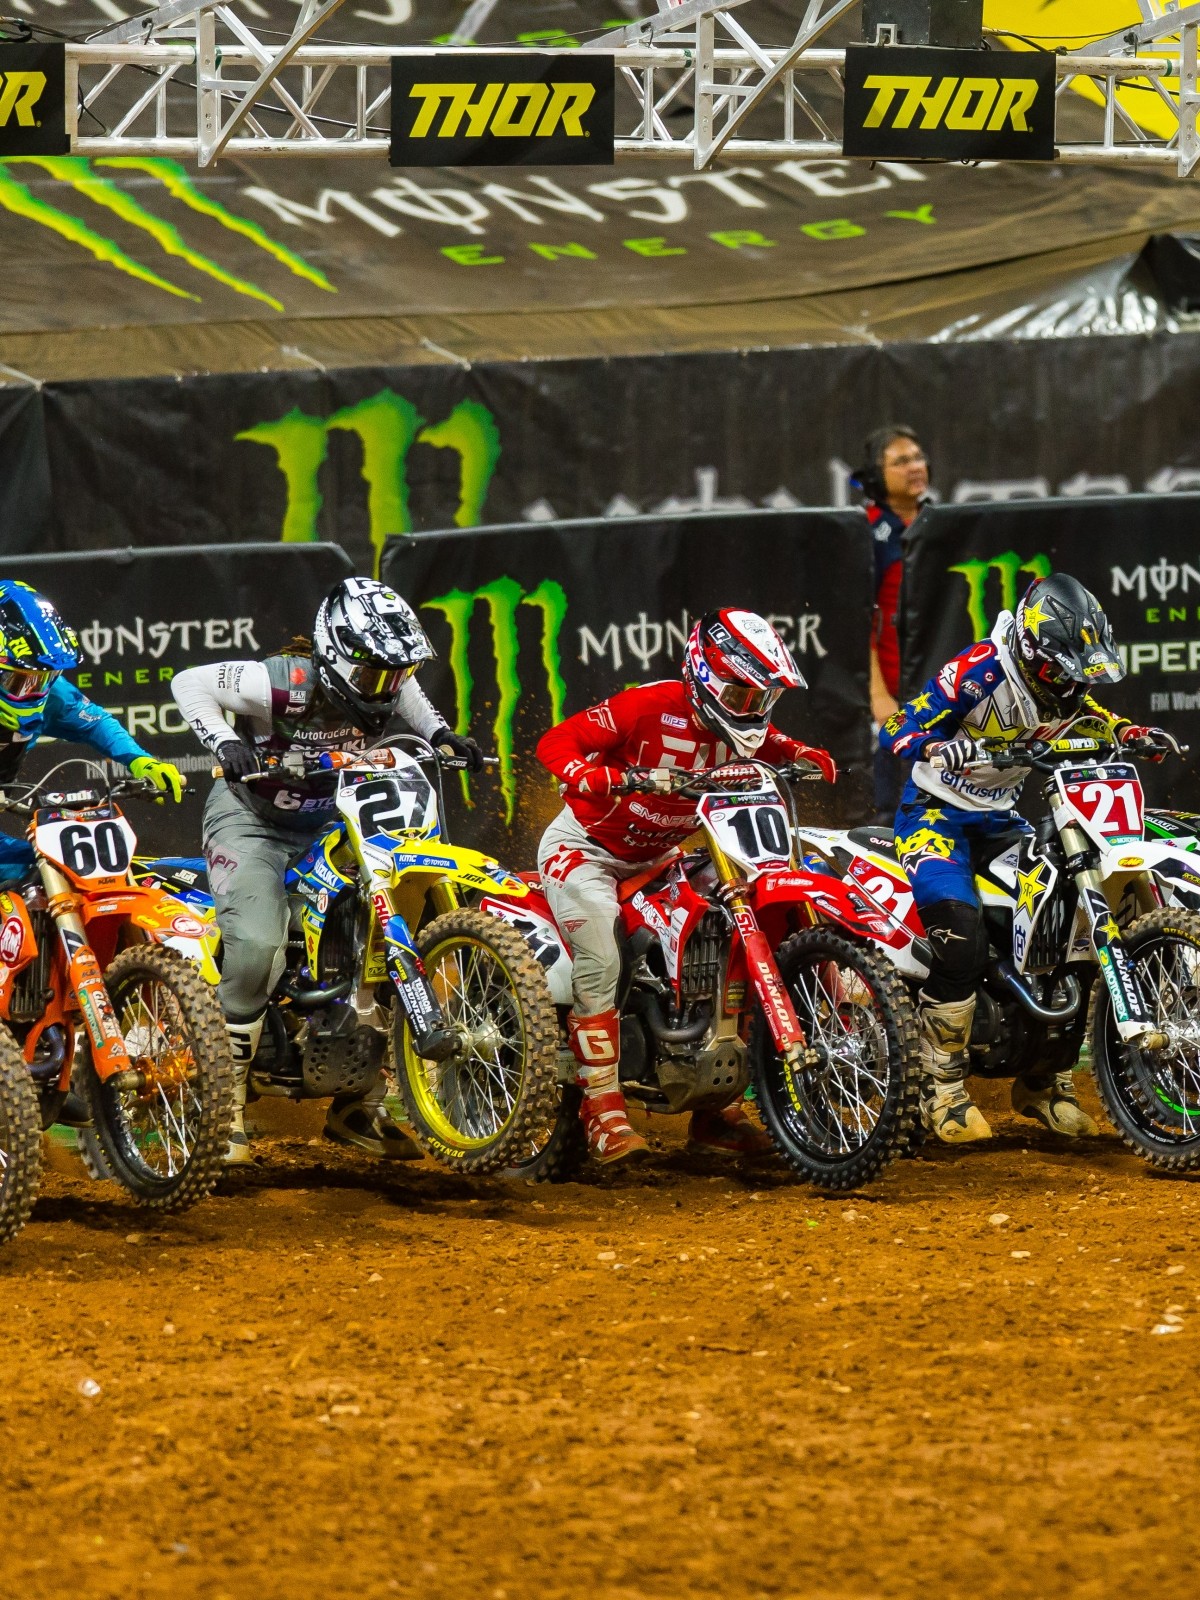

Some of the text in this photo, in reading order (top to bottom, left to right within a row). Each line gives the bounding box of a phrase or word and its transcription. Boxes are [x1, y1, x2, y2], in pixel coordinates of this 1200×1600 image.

[409, 82, 596, 138] THOR
[862, 75, 1039, 132] THOR
[241, 161, 925, 238] MONSTE
[440, 204, 936, 267] ENERGY
[9, 636, 32, 658] FLY
[80, 616, 260, 664] ONSTER
[577, 608, 828, 671] MONER
[1055, 653, 1076, 671] Airoh
[78, 668, 174, 689] ENER
[711, 766, 759, 779] NTHAL
[960, 780, 1012, 801] Husqv
[356, 779, 431, 839] 27
[727, 806, 790, 859] 10
[1082, 782, 1141, 833] 21
[59, 821, 129, 877] 60
[314, 856, 340, 887] SUZUKI
[430, 859, 450, 867] TOYOTA
[458, 873, 486, 884] JGR
[757, 962, 794, 1033] DUNLOP
[1104, 964, 1128, 1021] MOTOREX
[1112, 947, 1142, 1016] DUNLOP
[404, 983, 427, 1032] DUNLOP
[577, 1029, 614, 1060] G
[428, 1136, 465, 1158] DUNLOP
